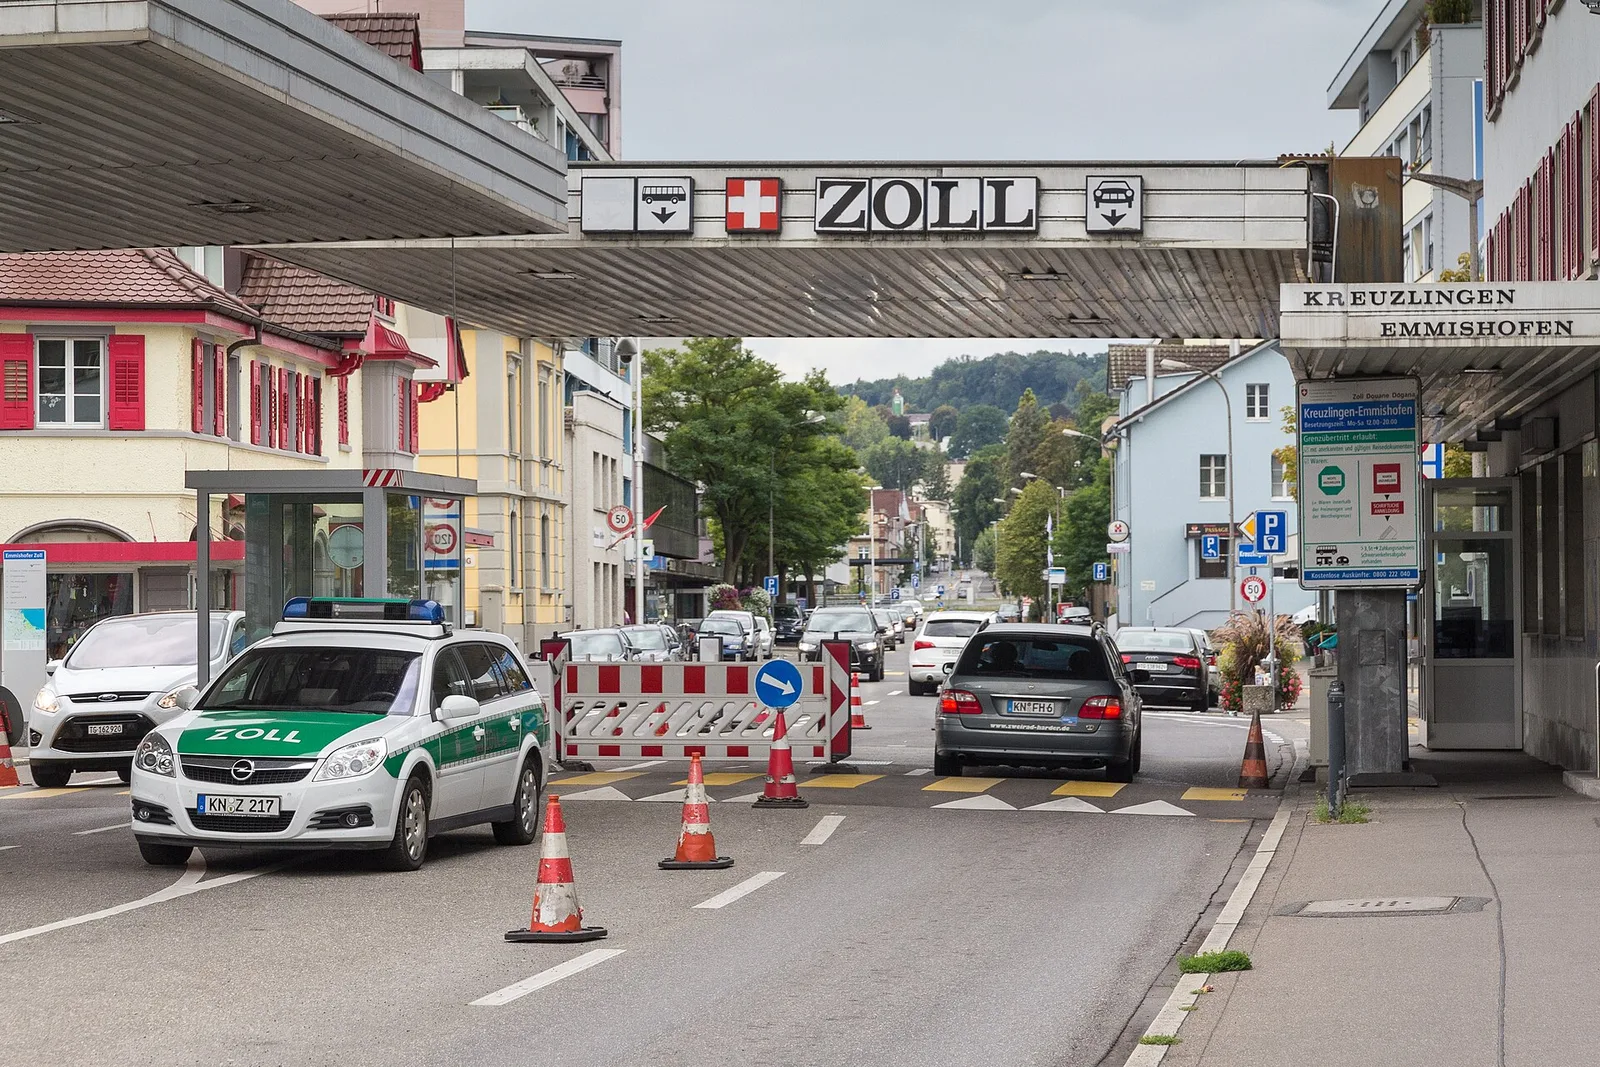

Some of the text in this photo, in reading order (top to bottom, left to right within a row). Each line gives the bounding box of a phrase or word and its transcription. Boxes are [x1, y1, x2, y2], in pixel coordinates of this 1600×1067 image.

[818, 179, 1034, 229] ZOLL
[1303, 289, 1516, 306] KREUZLINGEN
[1380, 320, 1573, 337] EMMISHOFEN
[1304, 404, 1413, 420] Kreuzlingen-Emmishofen
[1304, 434, 1350, 443] Grenzübertritt
[616, 514, 626, 524] 50
[1265, 514, 1278, 534] P
[1207, 538, 1214, 548] P
[1248, 584, 1260, 594] 50
[1014, 702, 1027, 712] KN
[204, 728, 302, 744] ZOLL
[210, 798, 274, 813] KN Z 217
